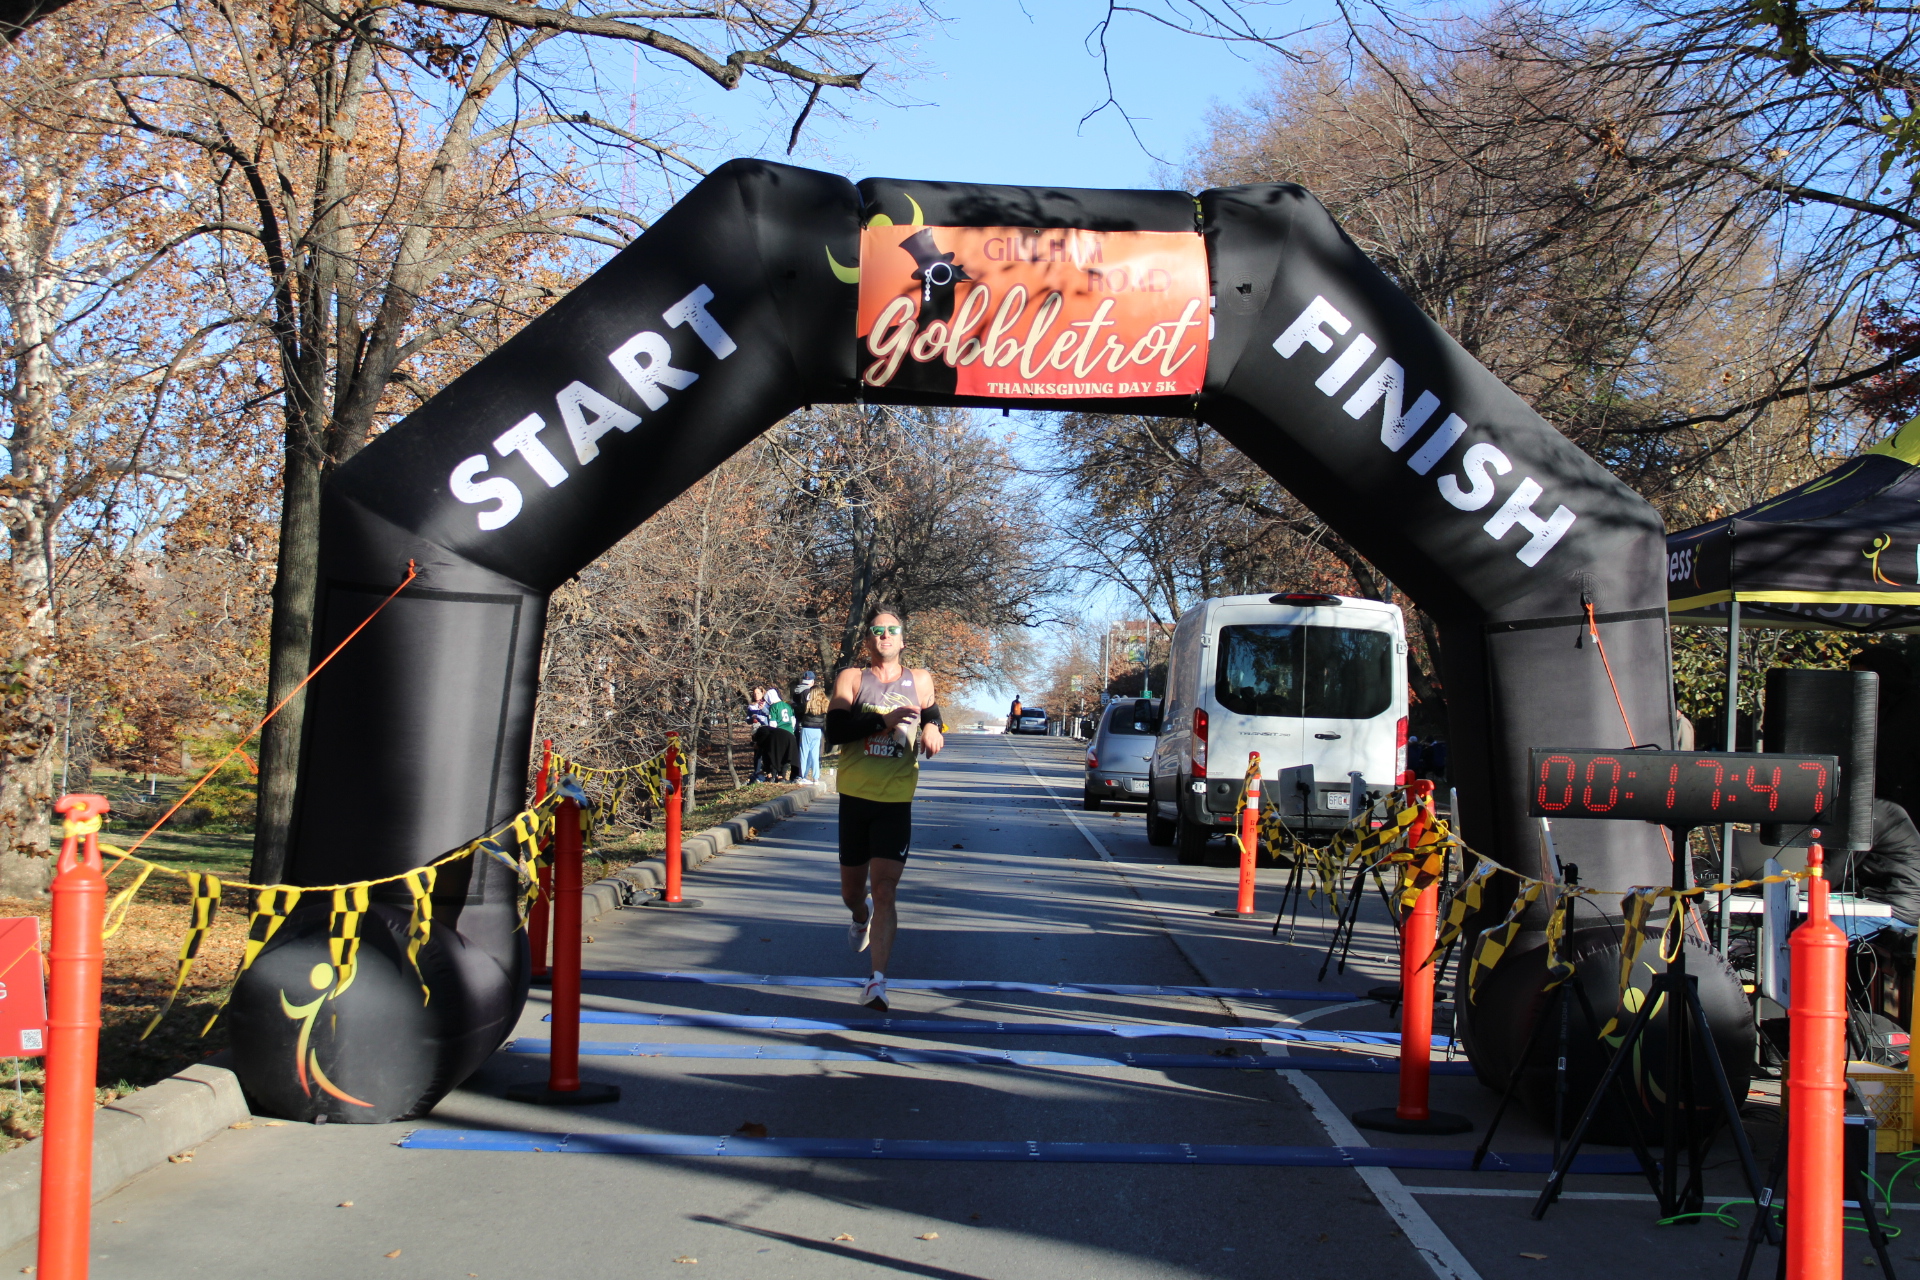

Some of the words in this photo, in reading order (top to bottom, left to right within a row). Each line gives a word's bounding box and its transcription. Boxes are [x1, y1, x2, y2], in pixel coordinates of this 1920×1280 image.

[983, 236, 1104, 264] GILLHAM
[1087, 267, 1172, 293] ROAD
[863, 284, 1202, 387] Gobbletrot
[450, 283, 738, 531] START
[987, 382, 1114, 395] THANKSGIVING
[1118, 382, 1152, 394] DAY
[1155, 381, 1177, 392] 5K
[1272, 295, 1577, 567] FINISH
[869, 744, 895, 756] 1032
[1538, 755, 1826, 813] 00:17:47
